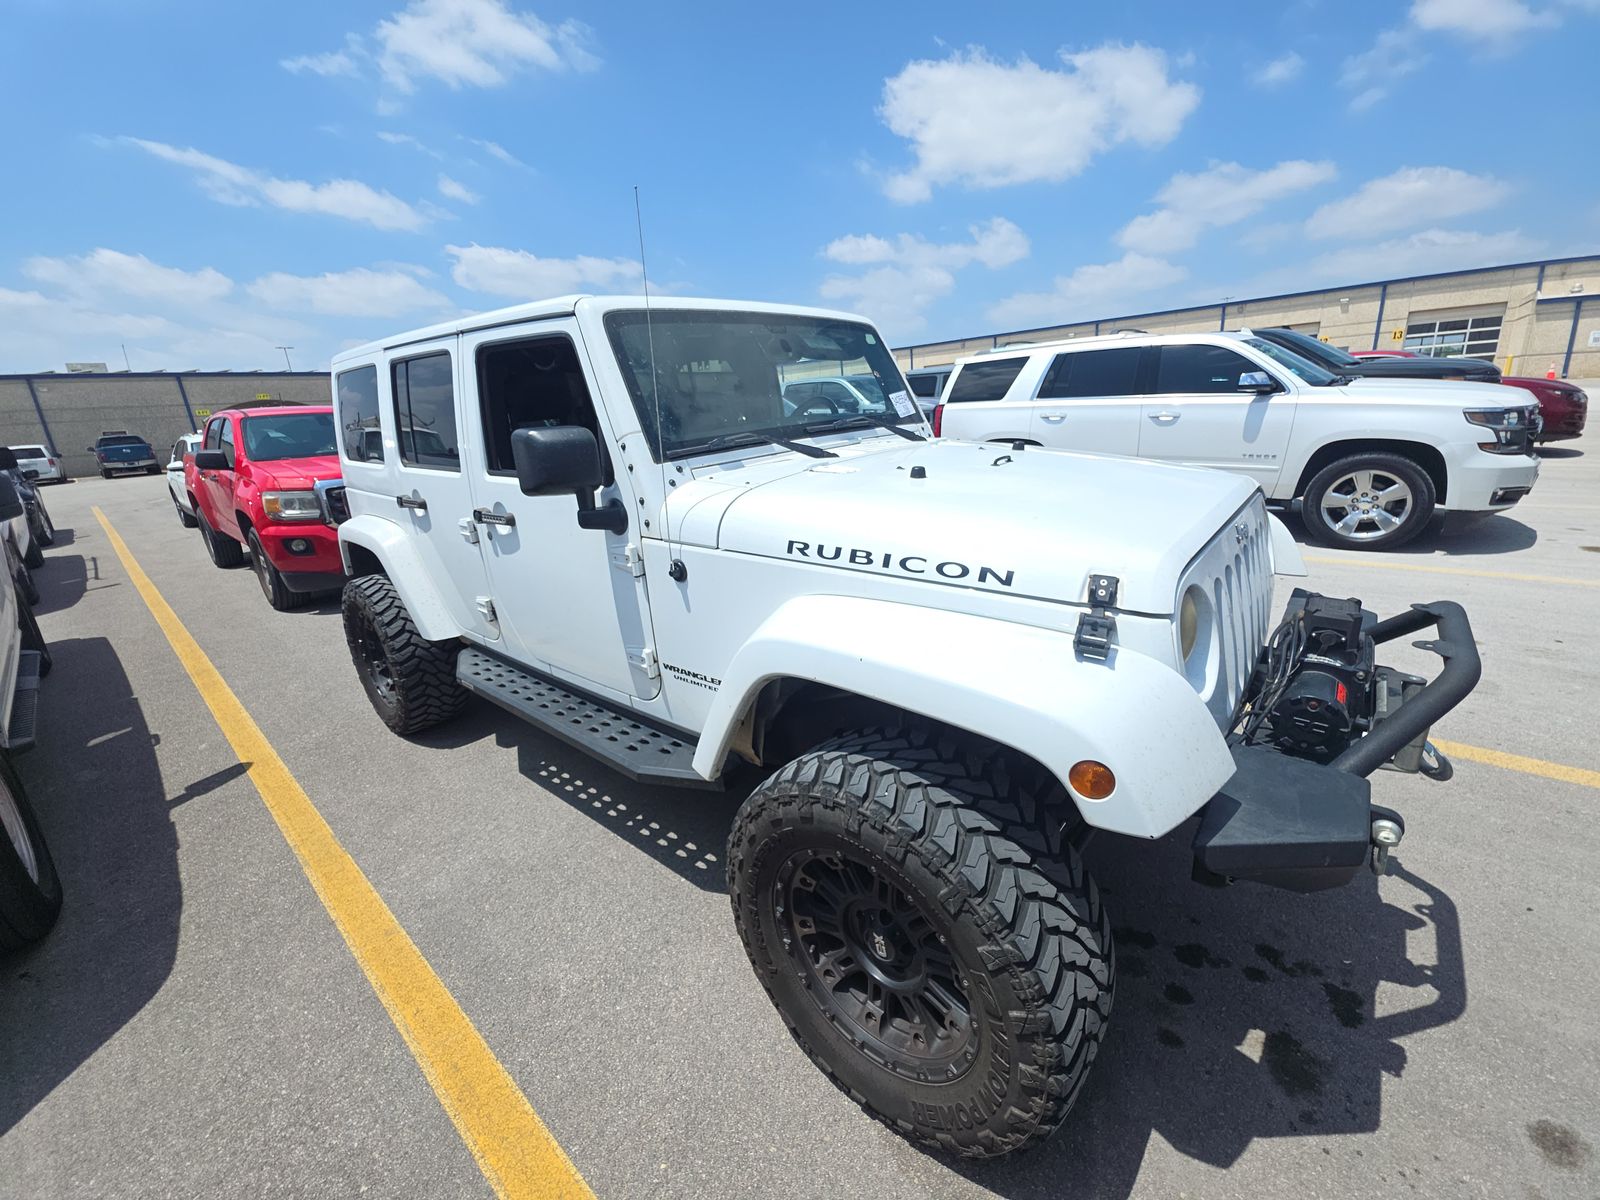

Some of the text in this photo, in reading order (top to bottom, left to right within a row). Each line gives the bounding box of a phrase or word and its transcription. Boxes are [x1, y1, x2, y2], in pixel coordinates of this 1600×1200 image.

[1392, 330, 1404, 340] 13
[786, 540, 1014, 586] RUBICON
[911, 1098, 989, 1131] POWER
